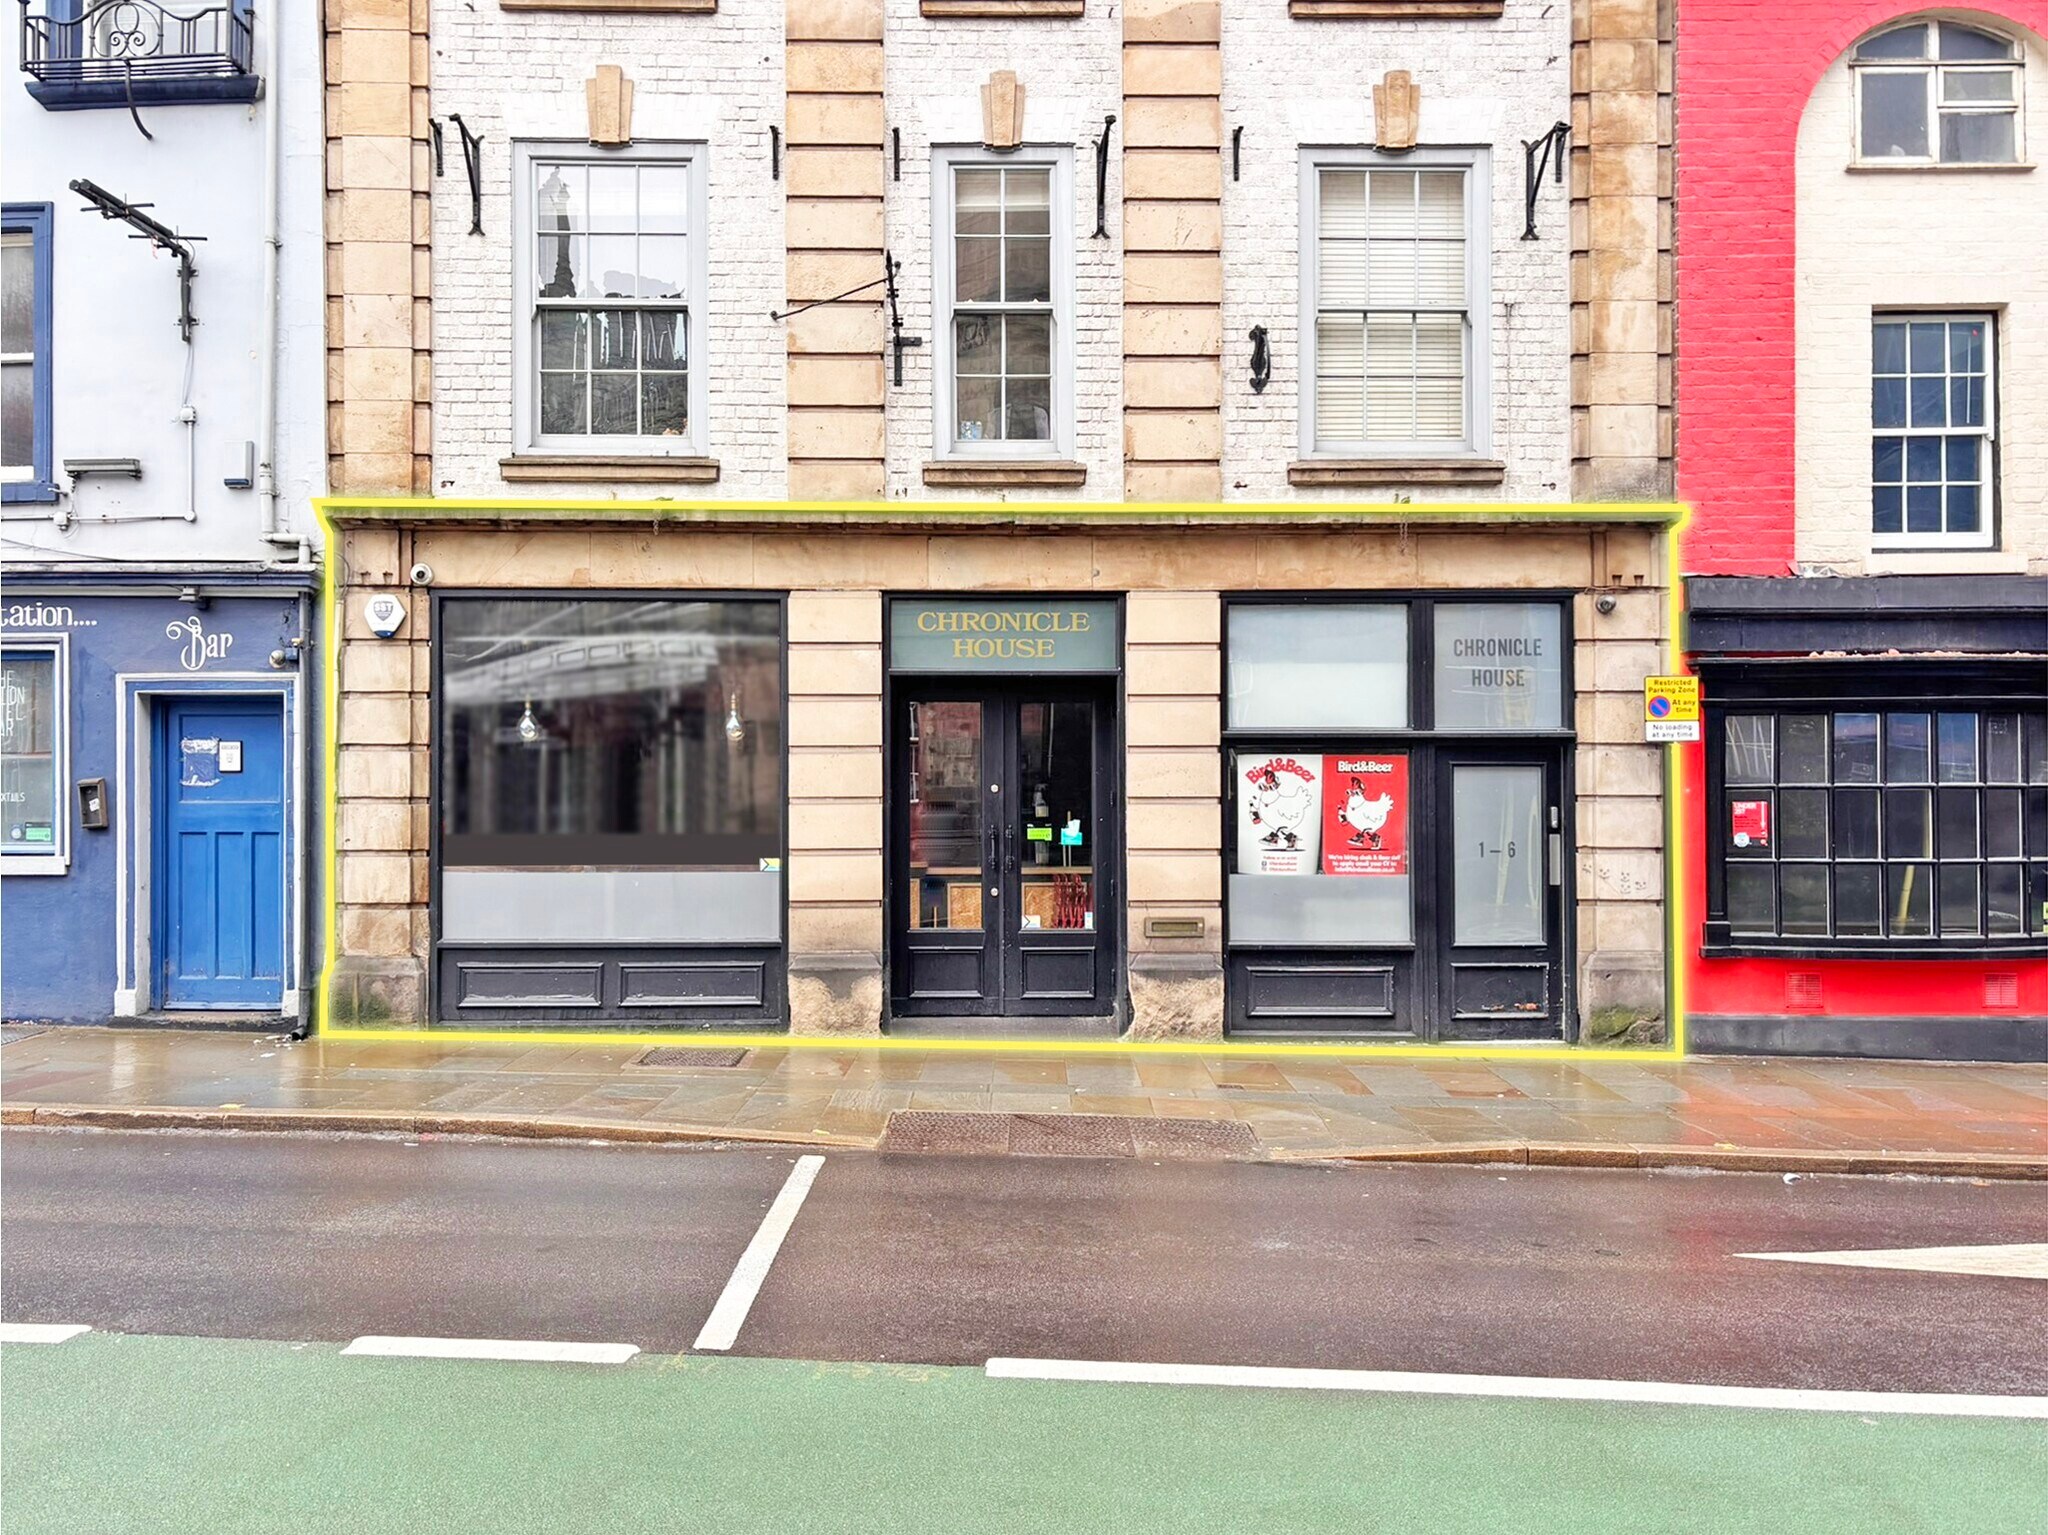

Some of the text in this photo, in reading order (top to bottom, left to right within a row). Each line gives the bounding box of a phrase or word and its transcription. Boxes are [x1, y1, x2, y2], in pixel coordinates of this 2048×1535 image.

[374, 602, 393, 612] SST
[917, 611, 1090, 632] CHRONICLE
[166, 616, 233, 671] Bar
[952, 638, 1055, 658] HOUSE
[1453, 638, 1542, 657] CHRONICLE
[1472, 669, 1525, 687] HOUSE
[1648, 686, 1676, 694] Parking
[1245, 757, 1316, 784] Bird&Beer
[1337, 761, 1393, 773] Bird&Beer
